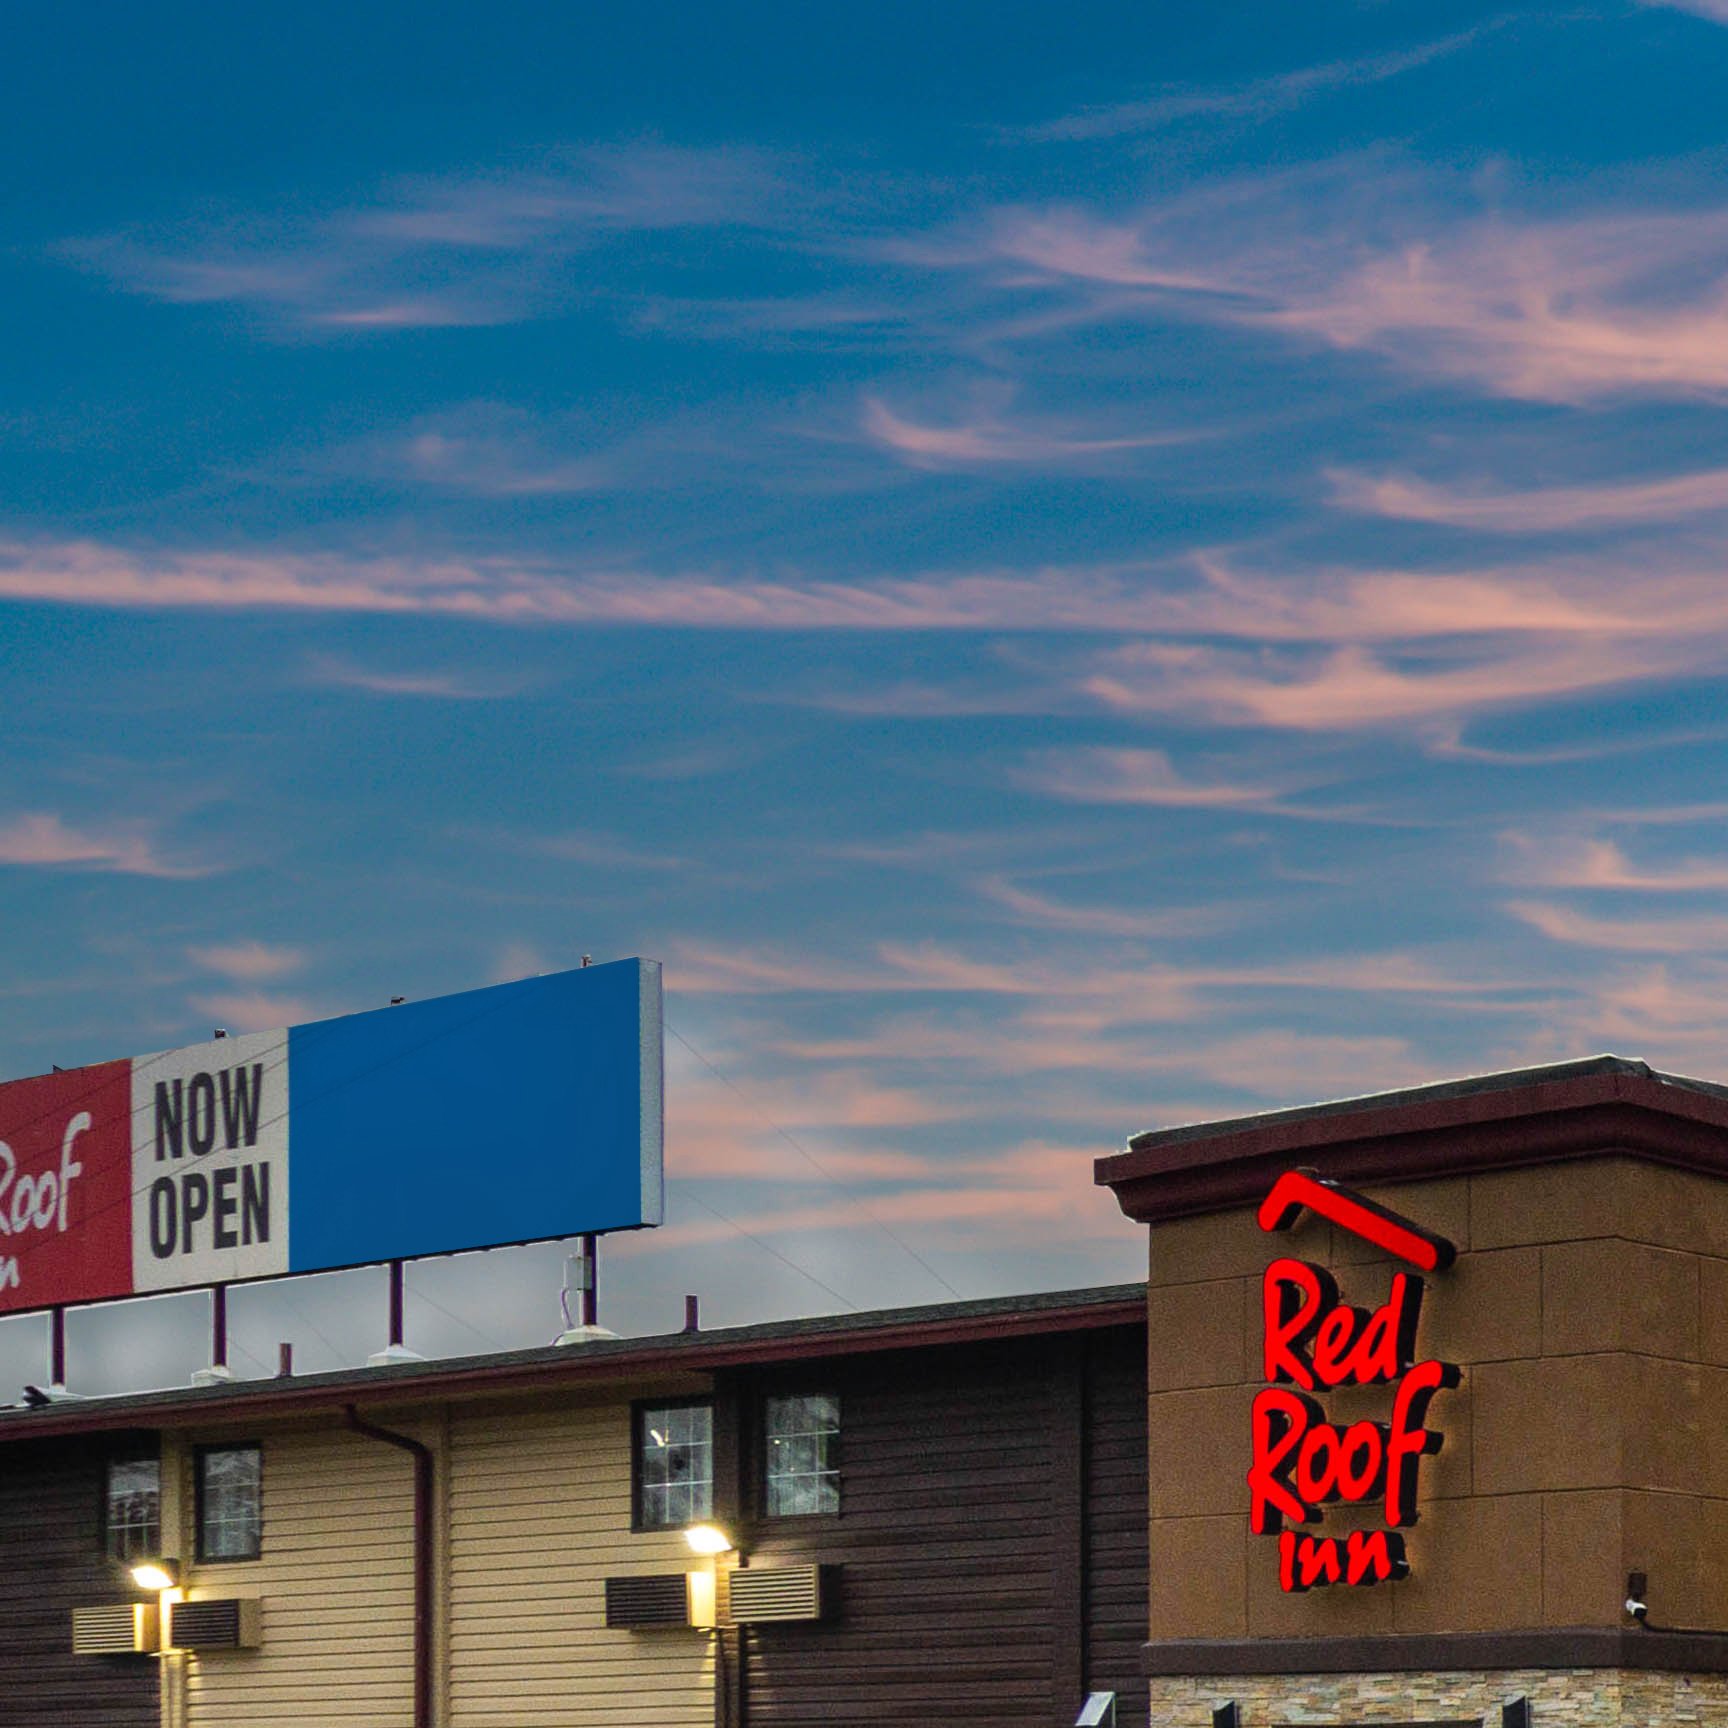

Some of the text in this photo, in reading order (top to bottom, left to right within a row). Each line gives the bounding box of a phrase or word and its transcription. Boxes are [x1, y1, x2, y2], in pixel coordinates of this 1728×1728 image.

[154, 1063, 263, 1162] NOW
[150, 1161, 270, 1260] OPEN
[1263, 1258, 1407, 1391] Red
[1247, 1360, 1444, 1535] Roof
